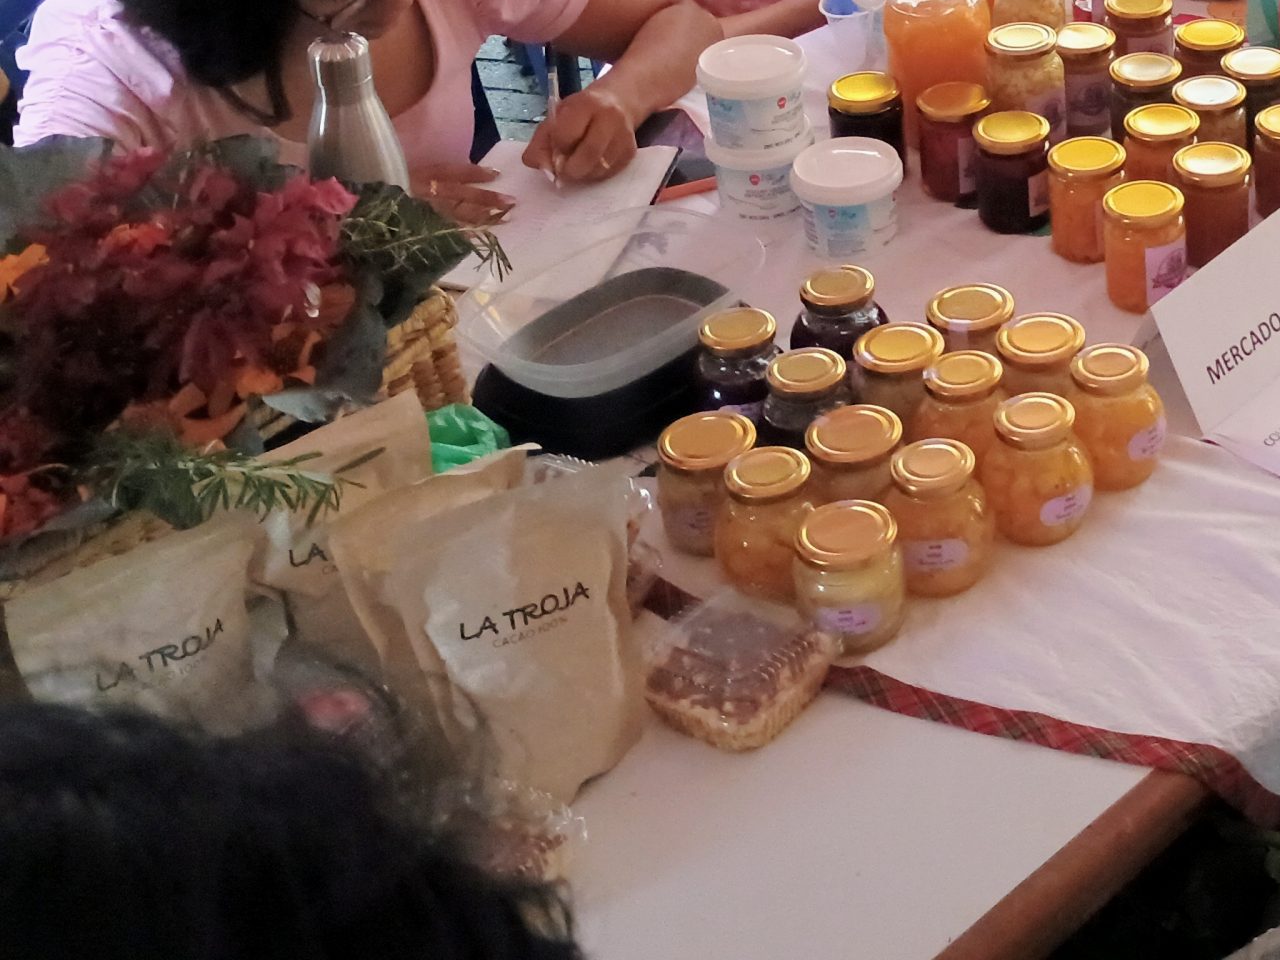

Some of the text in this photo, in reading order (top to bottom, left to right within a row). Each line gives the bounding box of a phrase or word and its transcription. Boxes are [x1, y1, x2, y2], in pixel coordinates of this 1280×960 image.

[288, 543, 328, 568] LA
[459, 581, 590, 640] LA TROJA
[96, 662, 136, 691] LA
